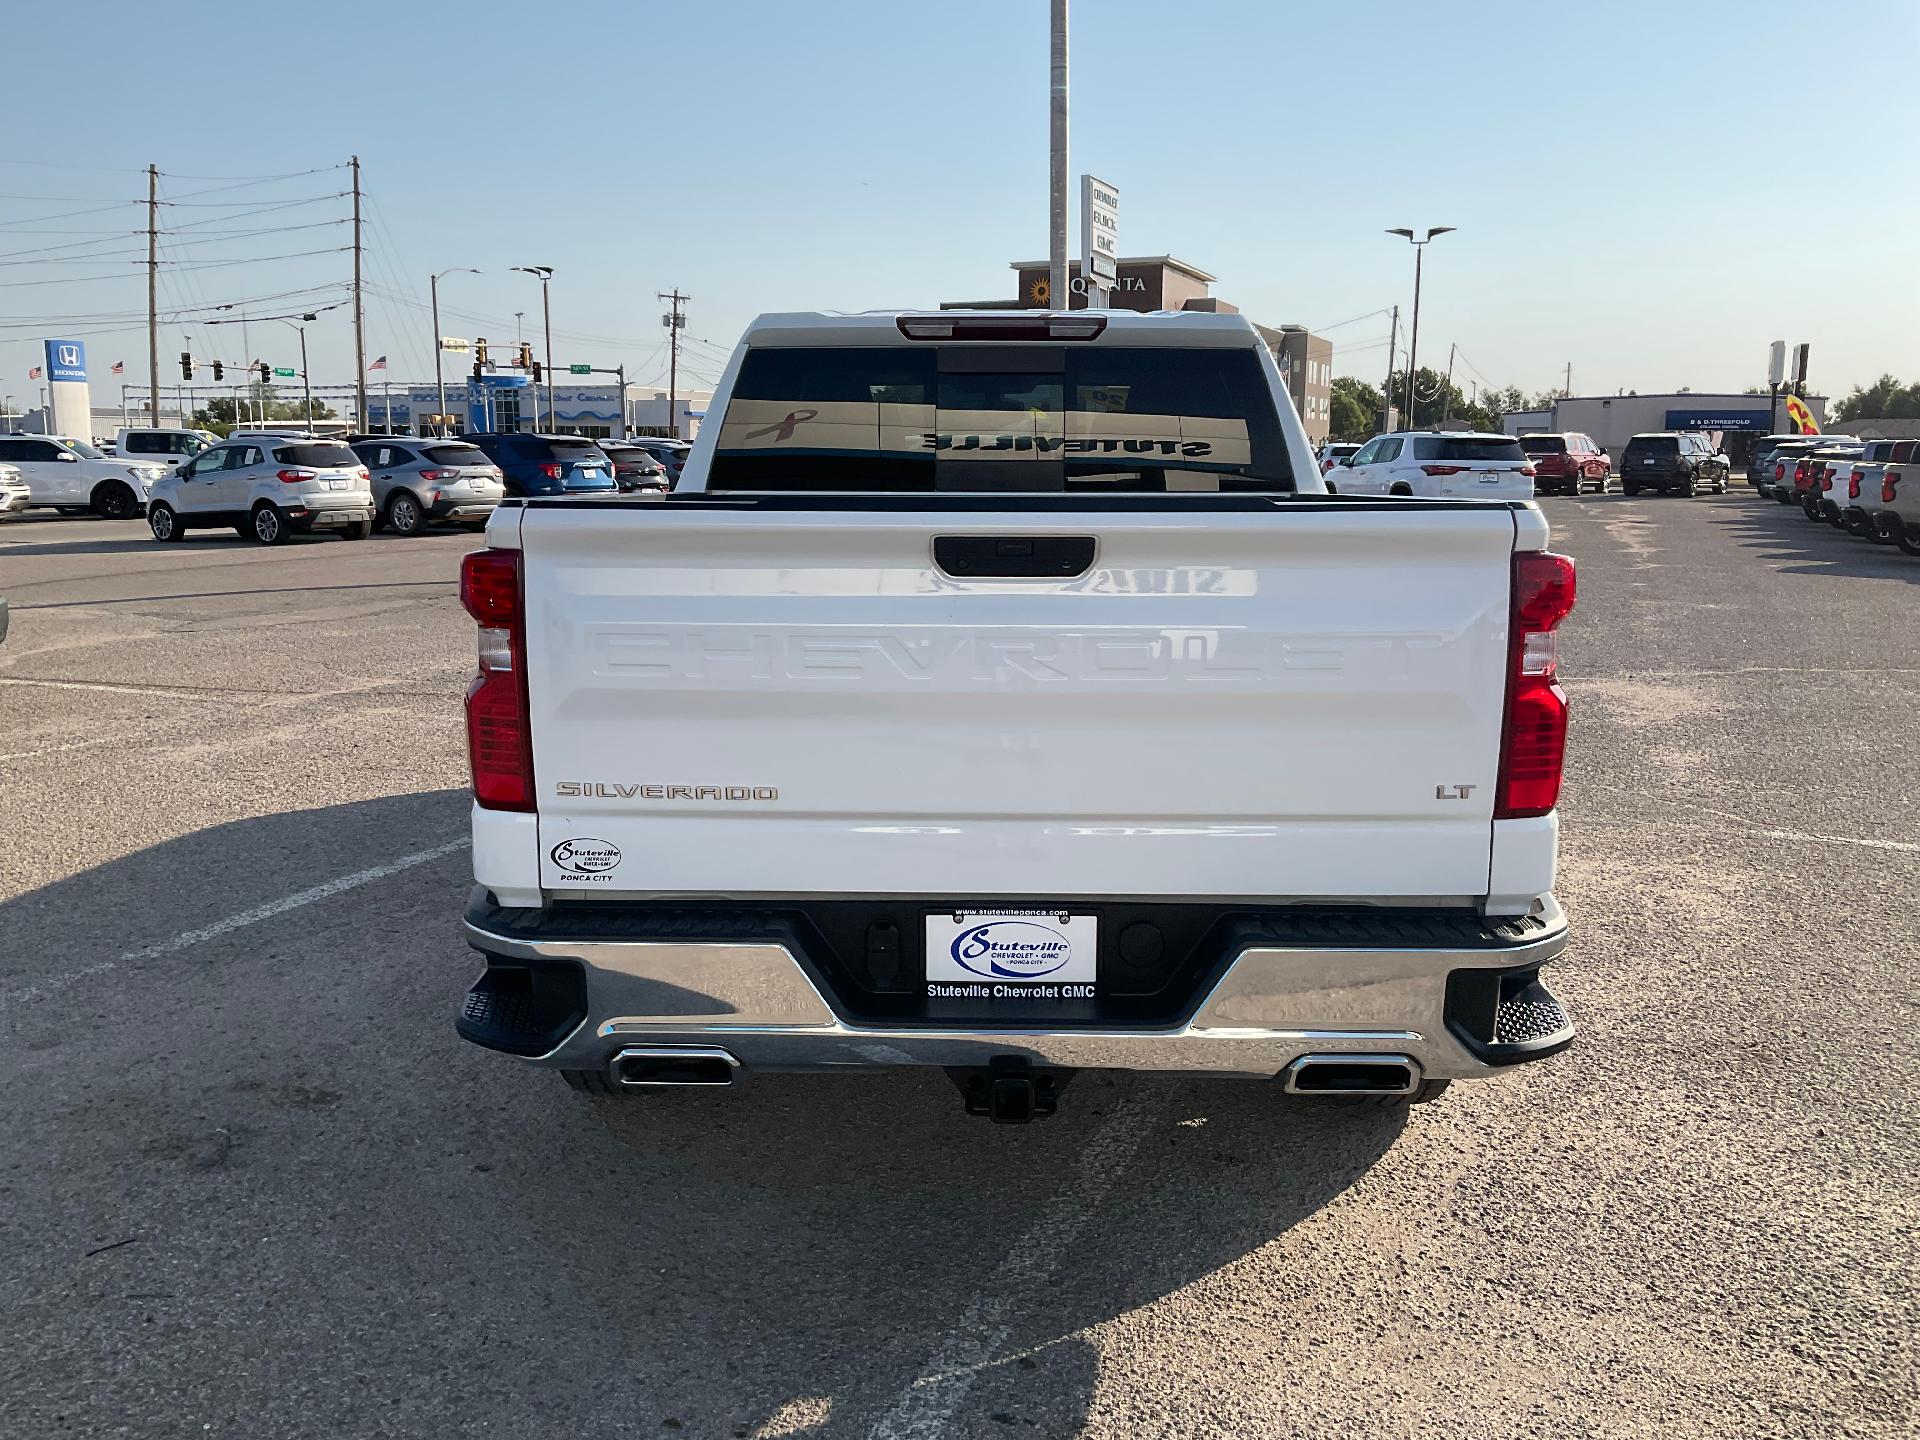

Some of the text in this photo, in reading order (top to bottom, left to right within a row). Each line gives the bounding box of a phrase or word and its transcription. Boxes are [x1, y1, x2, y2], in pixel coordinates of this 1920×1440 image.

[1093, 210, 1117, 232] BUICK
[1096, 234, 1114, 253] GMC
[591, 630, 1452, 682] CHEVROLET
[556, 781, 779, 801] SILVERADO
[1436, 784, 1477, 800] LT
[558, 842, 620, 861] Stuteville
[963, 928, 1068, 958] Stuteville
[927, 984, 1096, 998] Stuteville Chevrolet GMC
